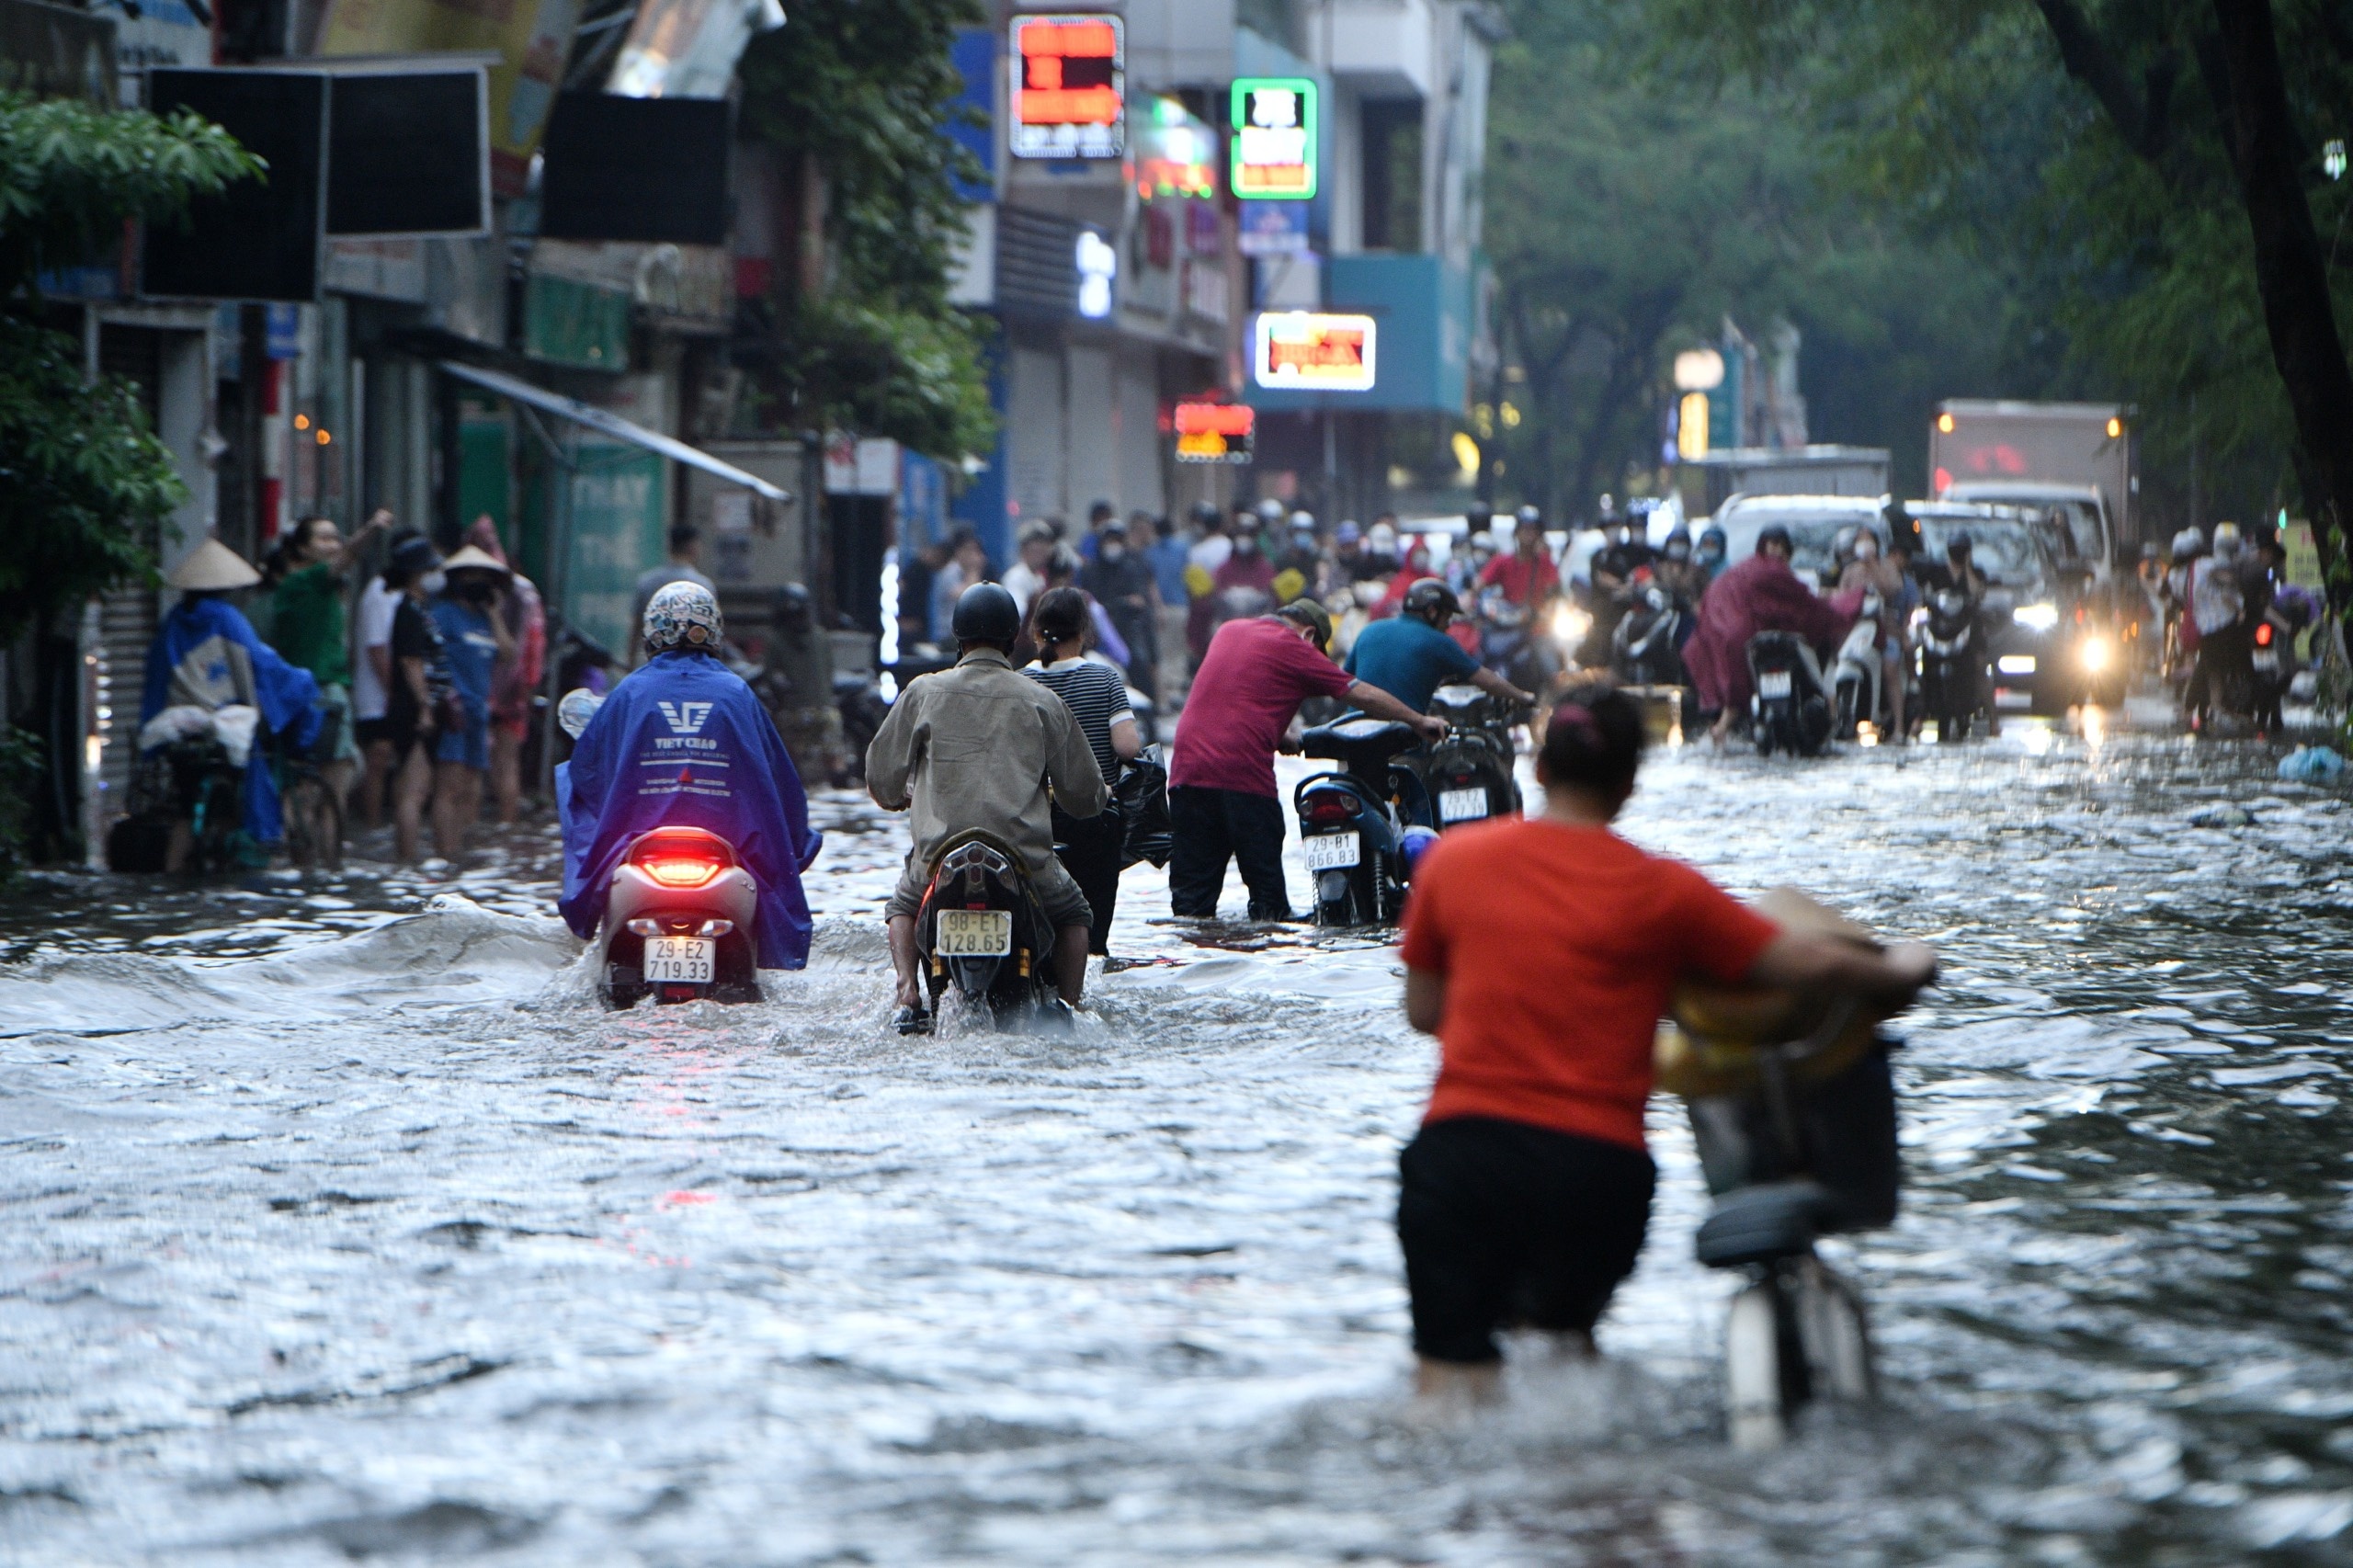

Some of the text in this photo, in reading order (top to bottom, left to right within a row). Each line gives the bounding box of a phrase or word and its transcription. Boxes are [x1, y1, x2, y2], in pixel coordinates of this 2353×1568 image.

[1313, 834, 1349, 853] 29-B1
[1308, 848, 1355, 868] 866.83
[949, 913, 999, 932] 98-E1
[656, 940, 704, 960] 29-E2
[944, 934, 1006, 953] 128.65
[650, 960, 709, 980] 719.33
